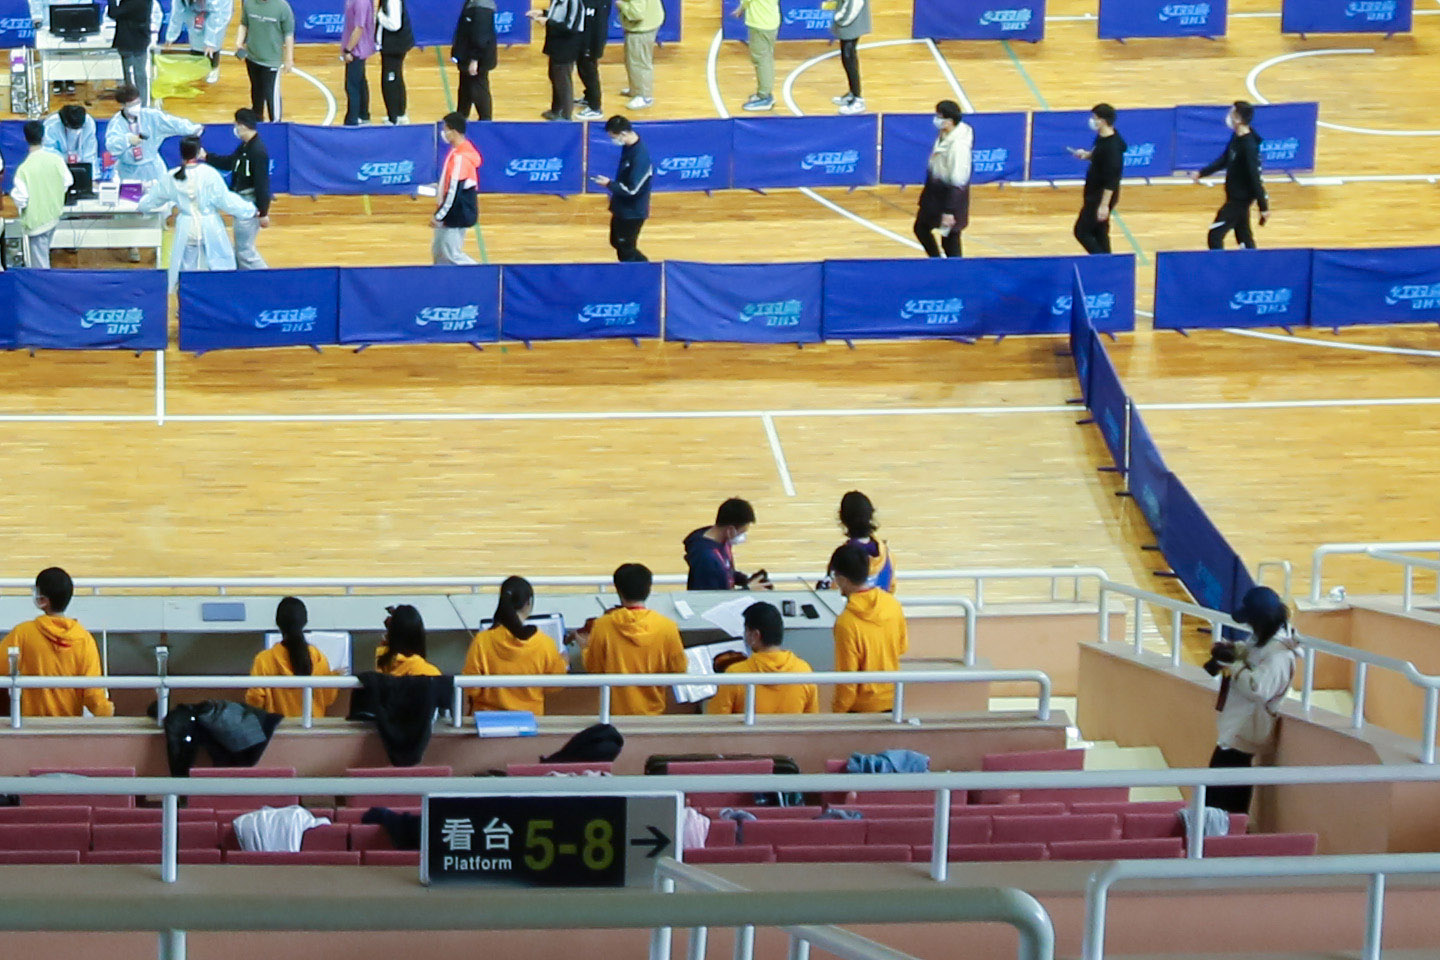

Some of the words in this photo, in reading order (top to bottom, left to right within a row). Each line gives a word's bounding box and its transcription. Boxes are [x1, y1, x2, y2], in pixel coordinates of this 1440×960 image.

[441, 817, 514, 851] 看台
[523, 818, 614, 871] 5-8
[443, 855, 512, 871] Platform
